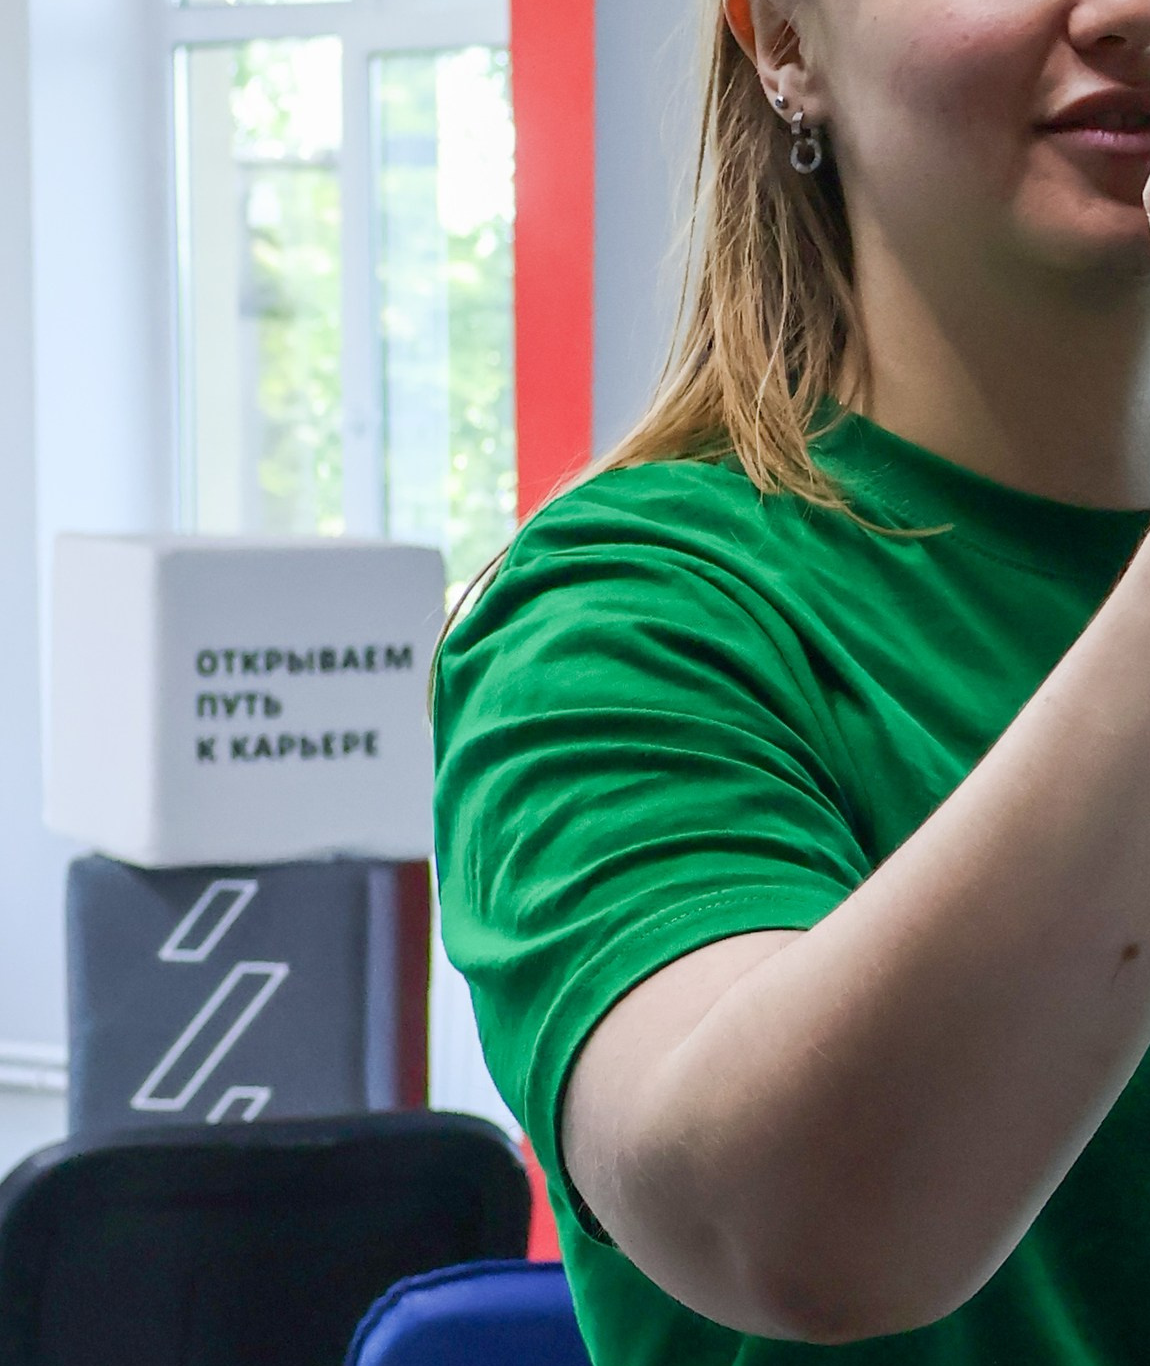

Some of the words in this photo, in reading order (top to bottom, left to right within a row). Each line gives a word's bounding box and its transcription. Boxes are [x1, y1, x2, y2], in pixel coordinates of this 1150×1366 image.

[197, 644, 413, 676] ОТКРЫВАЕМ
[197, 692, 283, 718] ПУТЬ
[197, 736, 216, 762] К
[230, 731, 380, 761] КАРЬЕРЕ
